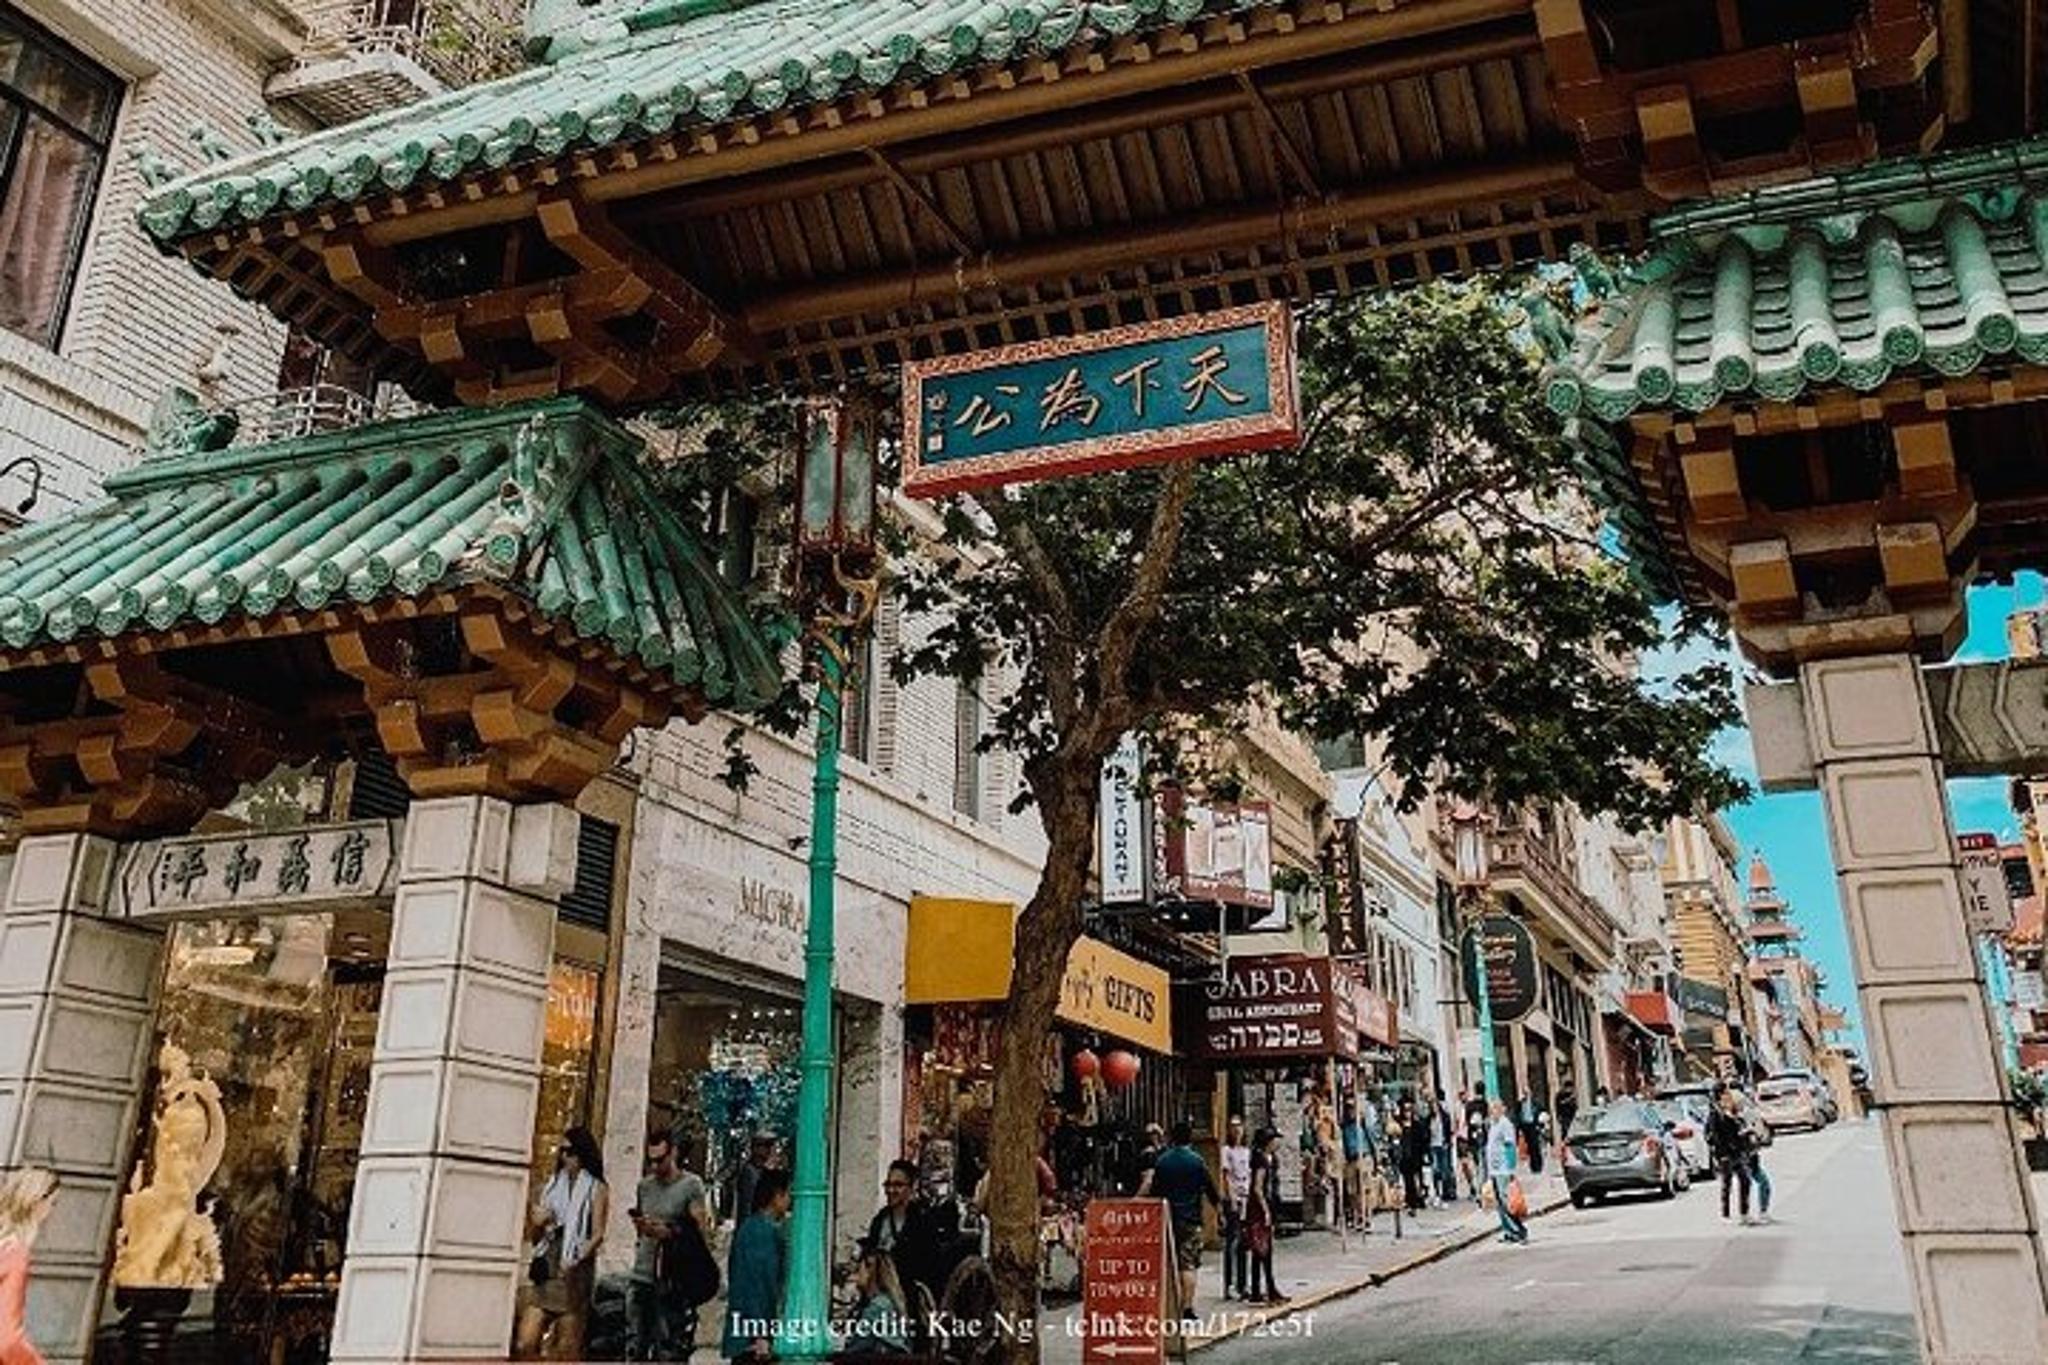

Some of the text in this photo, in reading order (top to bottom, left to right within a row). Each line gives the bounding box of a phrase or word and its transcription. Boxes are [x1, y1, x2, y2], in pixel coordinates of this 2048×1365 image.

[954, 343, 1249, 438] 天下為公
[1104, 974, 1156, 1025] GIFTS
[1204, 966, 1322, 1000] SABRA
[1099, 1258, 1151, 1276] UP TO
